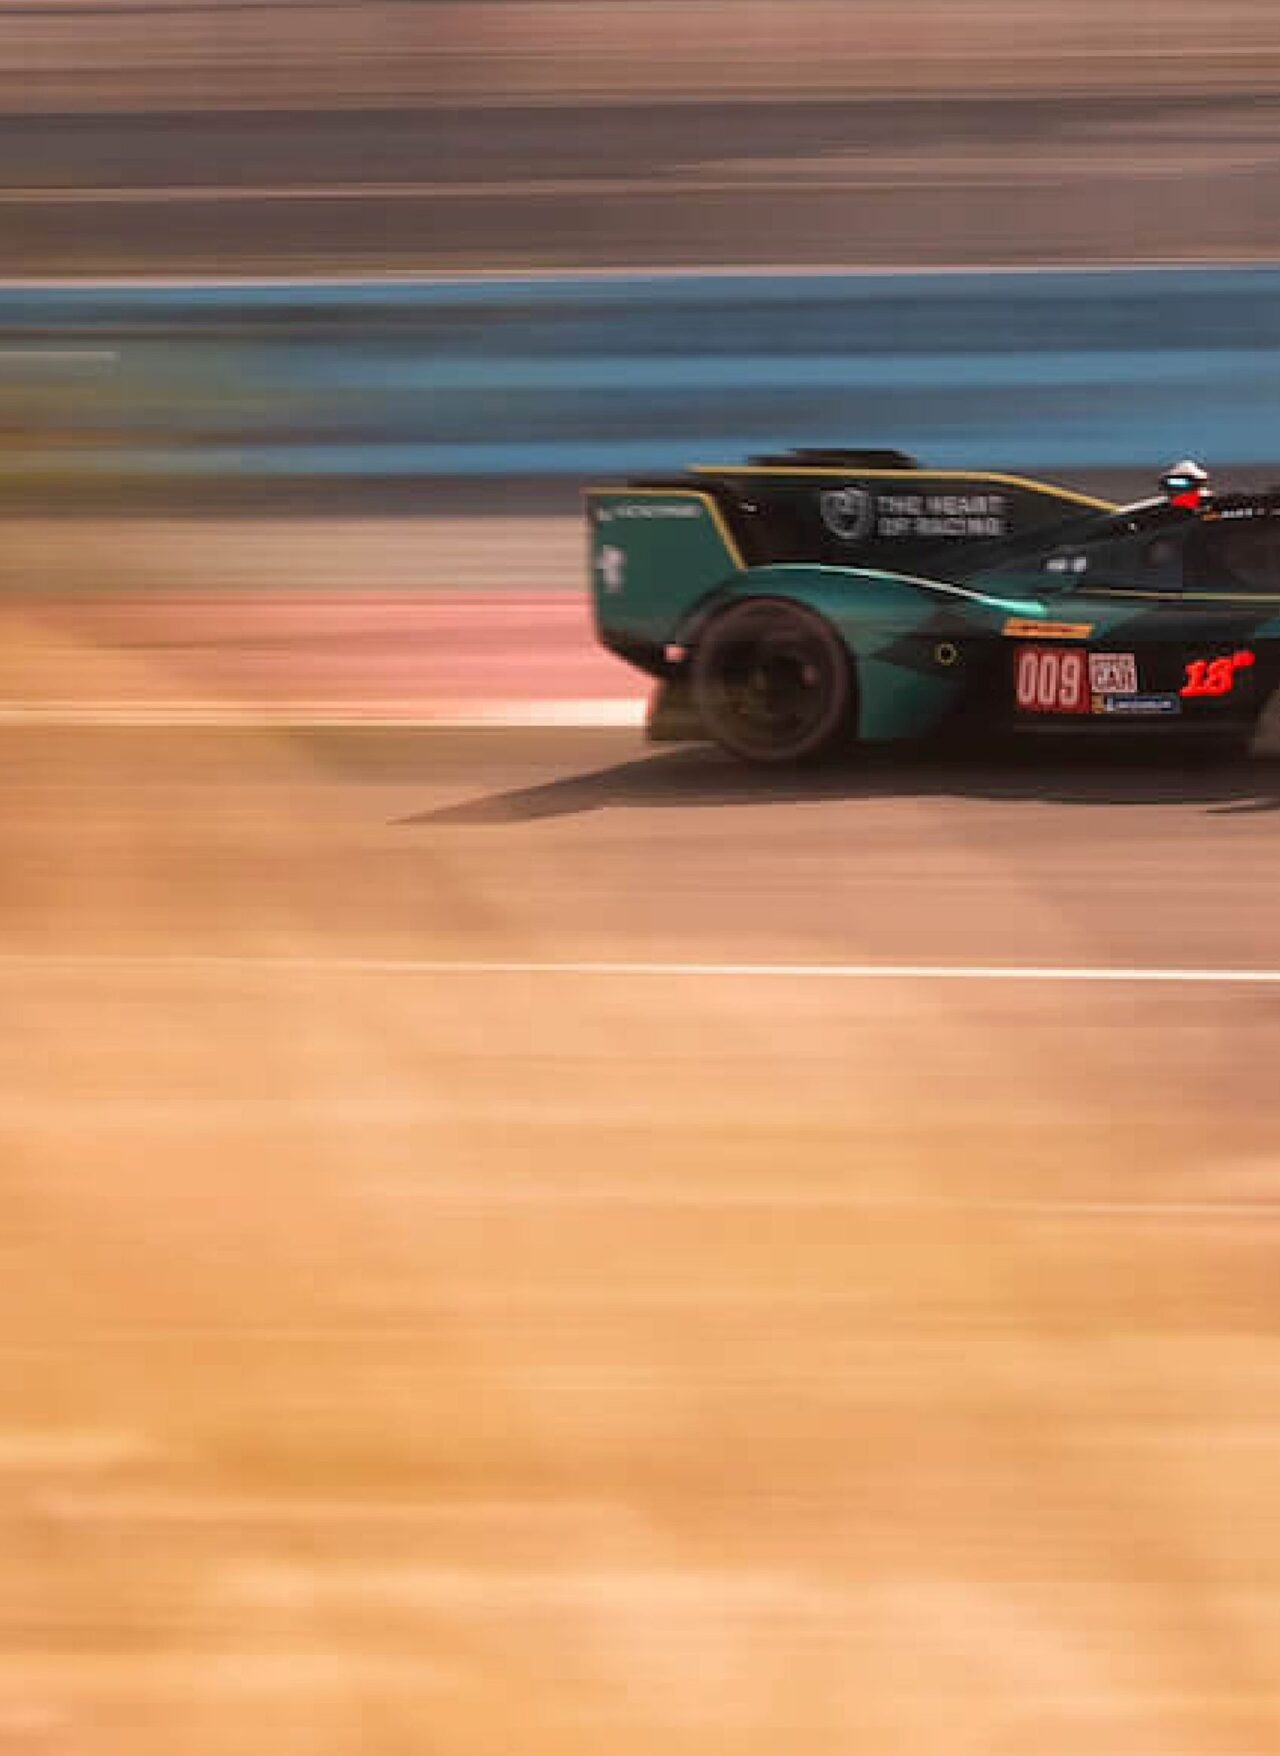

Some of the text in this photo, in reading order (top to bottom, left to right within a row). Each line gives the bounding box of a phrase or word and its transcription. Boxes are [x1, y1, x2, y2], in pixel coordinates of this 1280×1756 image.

[878, 496, 1006, 515] THE HEART
[1018, 653, 1081, 705] 009
